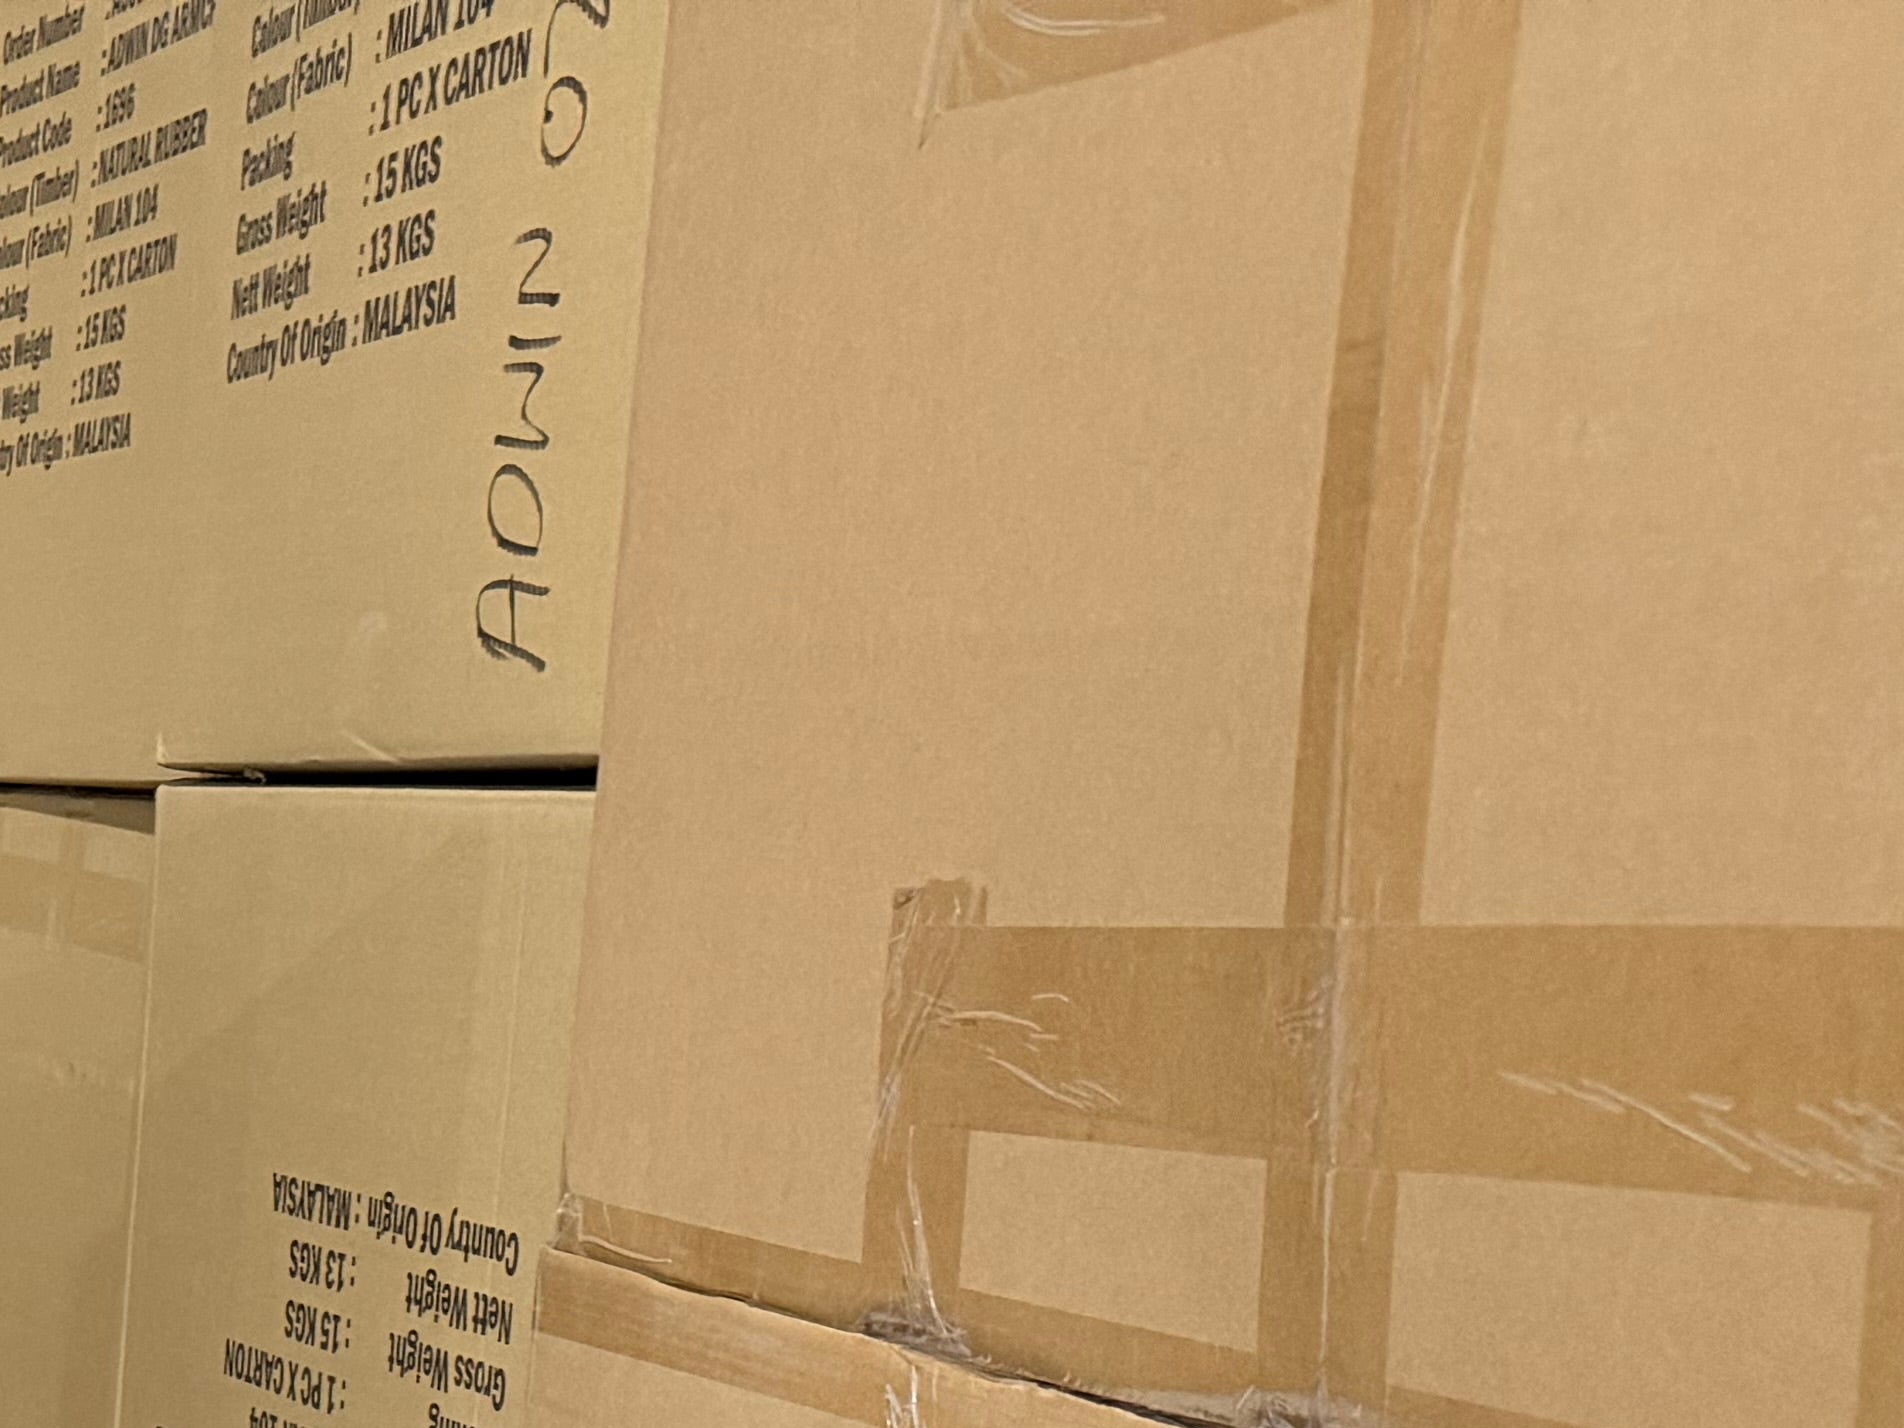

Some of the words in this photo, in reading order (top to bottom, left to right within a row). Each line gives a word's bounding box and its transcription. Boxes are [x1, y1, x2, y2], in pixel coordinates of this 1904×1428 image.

[241, 131, 296, 191] Packing
[380, 84, 391, 131] 1
[395, 72, 423, 125] PC
[424, 64, 441, 114] X
[443, 28, 532, 106] CARTON
[227, 334, 278, 384] Country
[280, 320, 299, 367] Of
[300, 309, 346, 366] Origin
[362, 275, 455, 344] MALAYSIA
[273, 1173, 352, 1231] MALAYSIA
[368, 1191, 418, 1249] Origin
[419, 1211, 442, 1256] Of
[445, 1207, 519, 1276] Country
